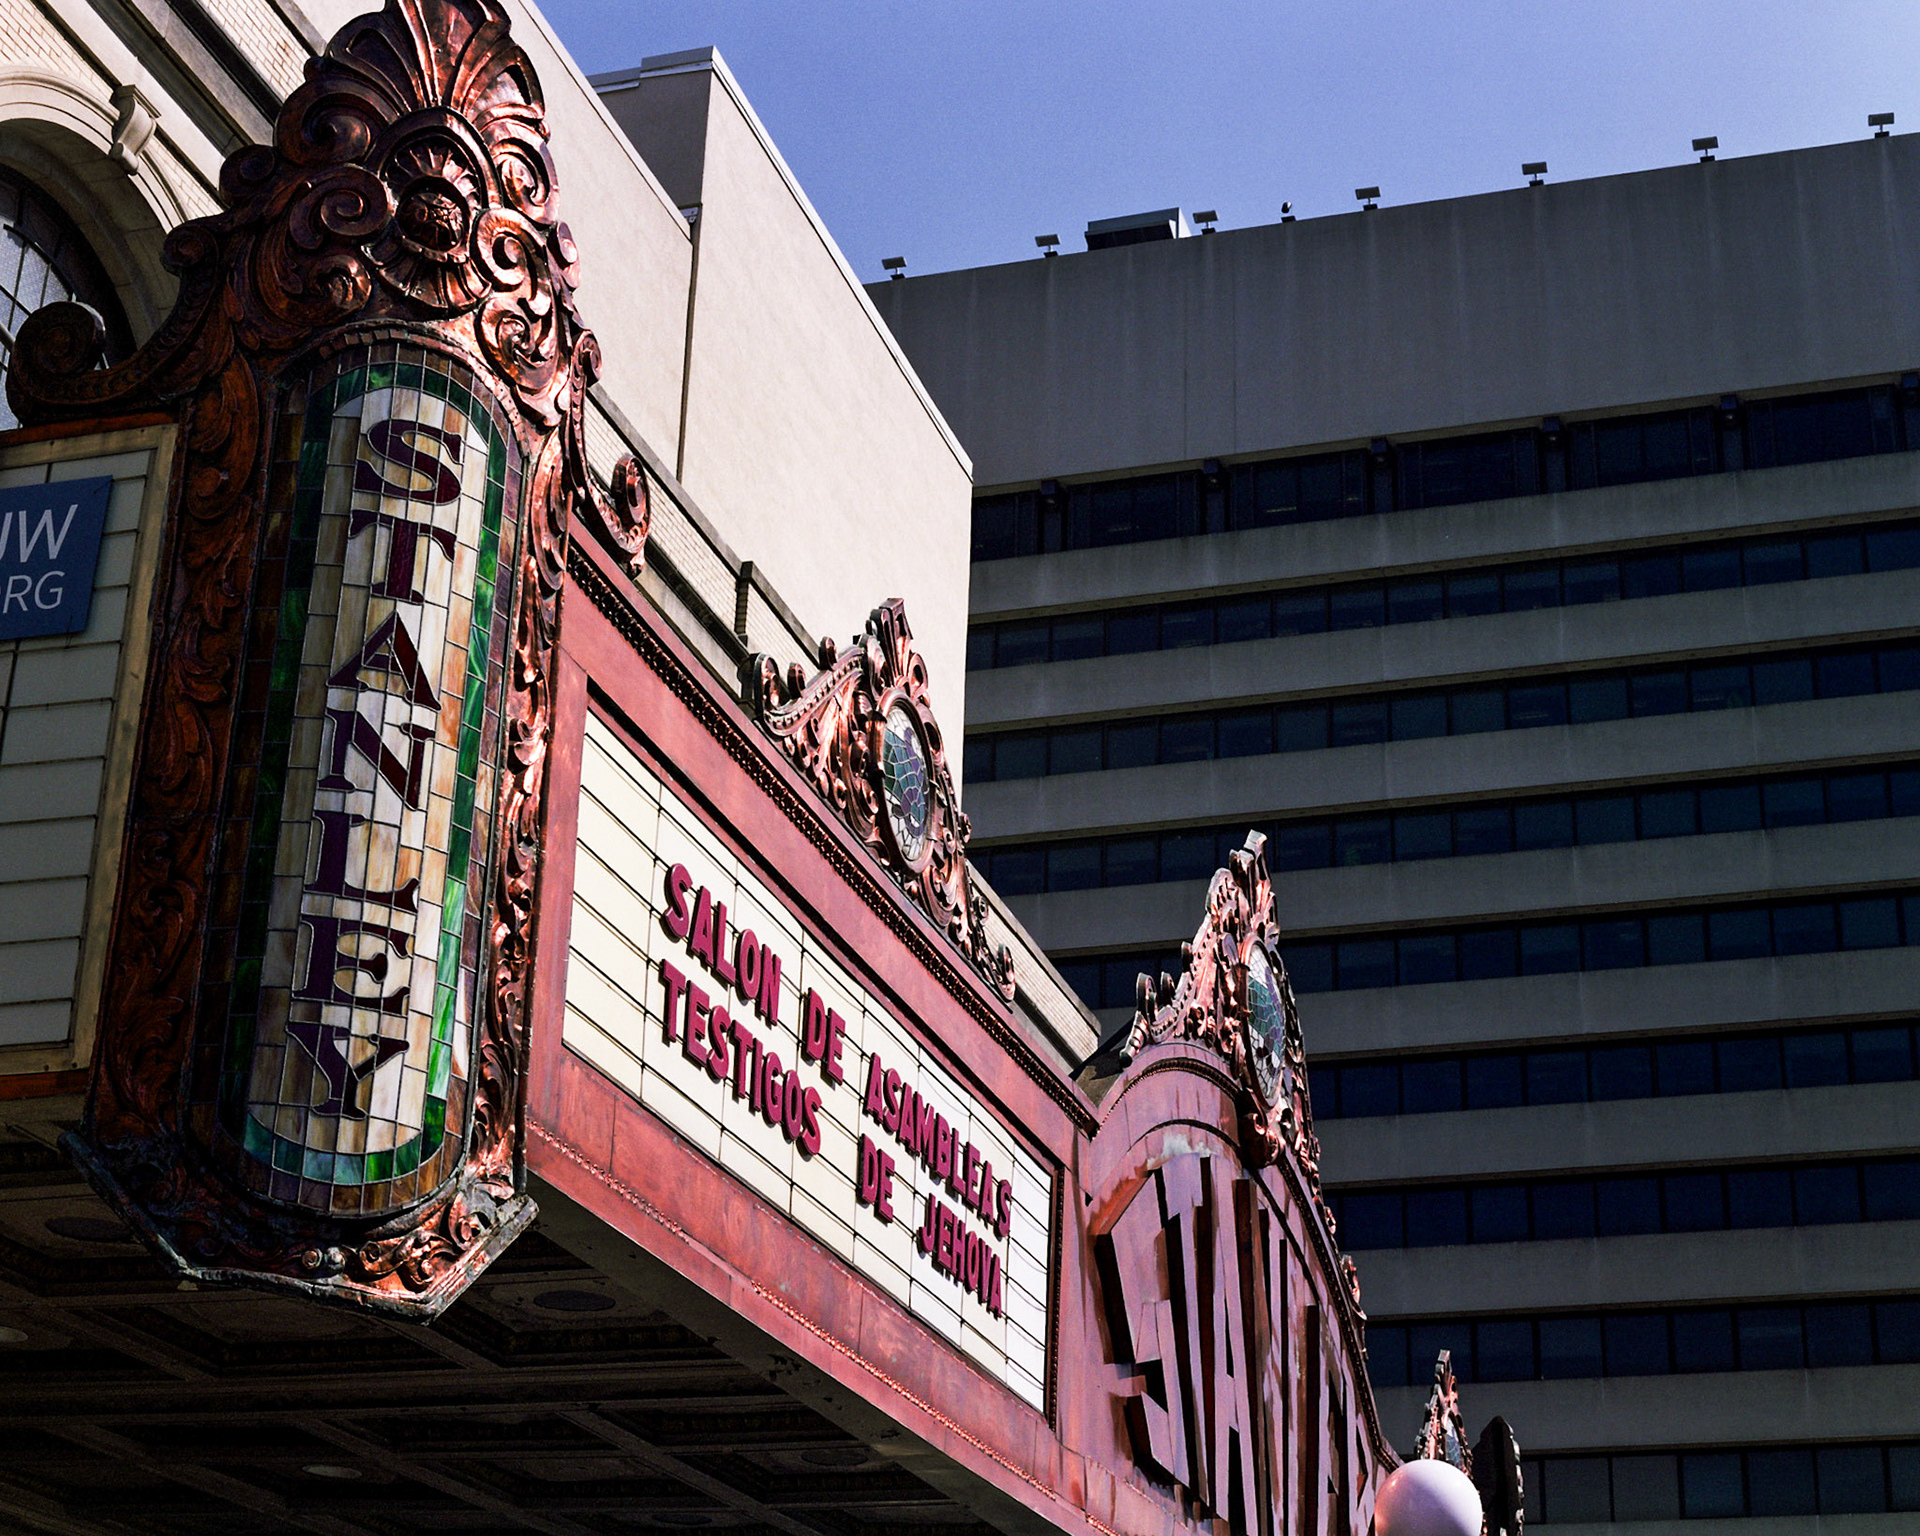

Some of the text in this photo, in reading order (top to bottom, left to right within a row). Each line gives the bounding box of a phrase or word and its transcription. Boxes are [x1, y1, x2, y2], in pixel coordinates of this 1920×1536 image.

[0, 570, 66, 614] RG
[284, 418, 463, 1120] STANLEY
[660, 958, 1003, 1319] TESTIGOS DE JEHOVA
[662, 862, 1013, 1238] SALON DE ASAMBLEAS
